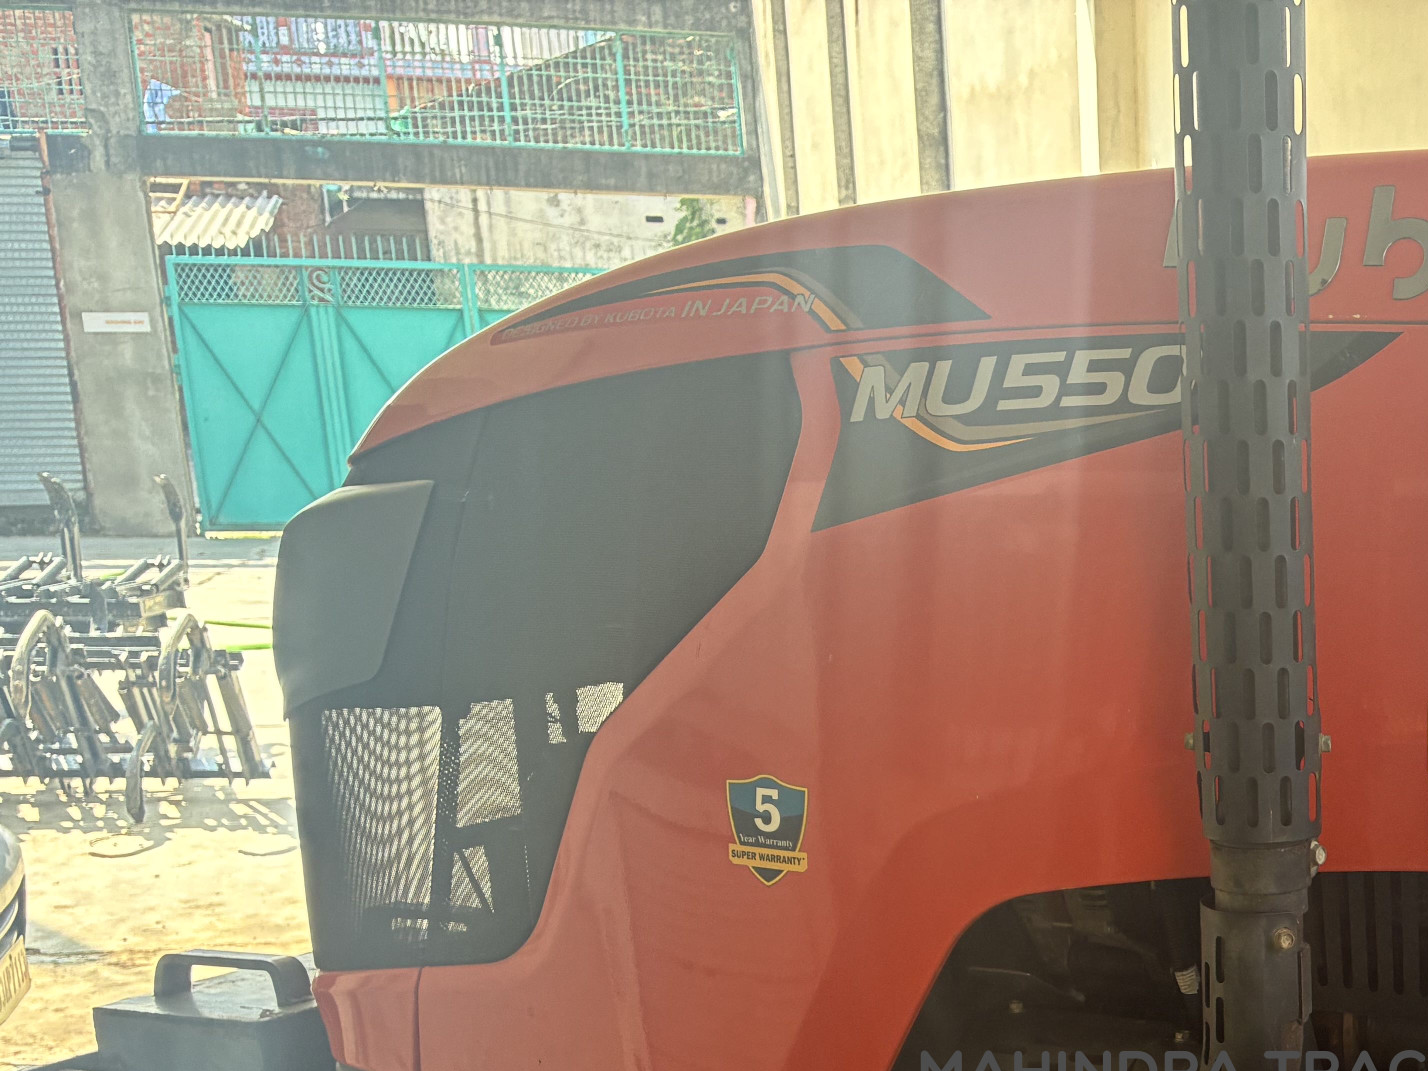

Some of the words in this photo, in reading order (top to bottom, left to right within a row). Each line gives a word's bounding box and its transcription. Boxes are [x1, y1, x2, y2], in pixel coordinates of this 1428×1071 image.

[502, 316, 579, 340] DESIGNED
[579, 313, 602, 327] BY
[603, 306, 677, 324] KUBOTA
[681, 298, 712, 318] IN
[712, 293, 816, 316] JAPAN
[754, 786, 781, 832] 5
[731, 849, 757, 861] SUPER
[739, 833, 756, 843] Year
[758, 835, 794, 849] Warranty
